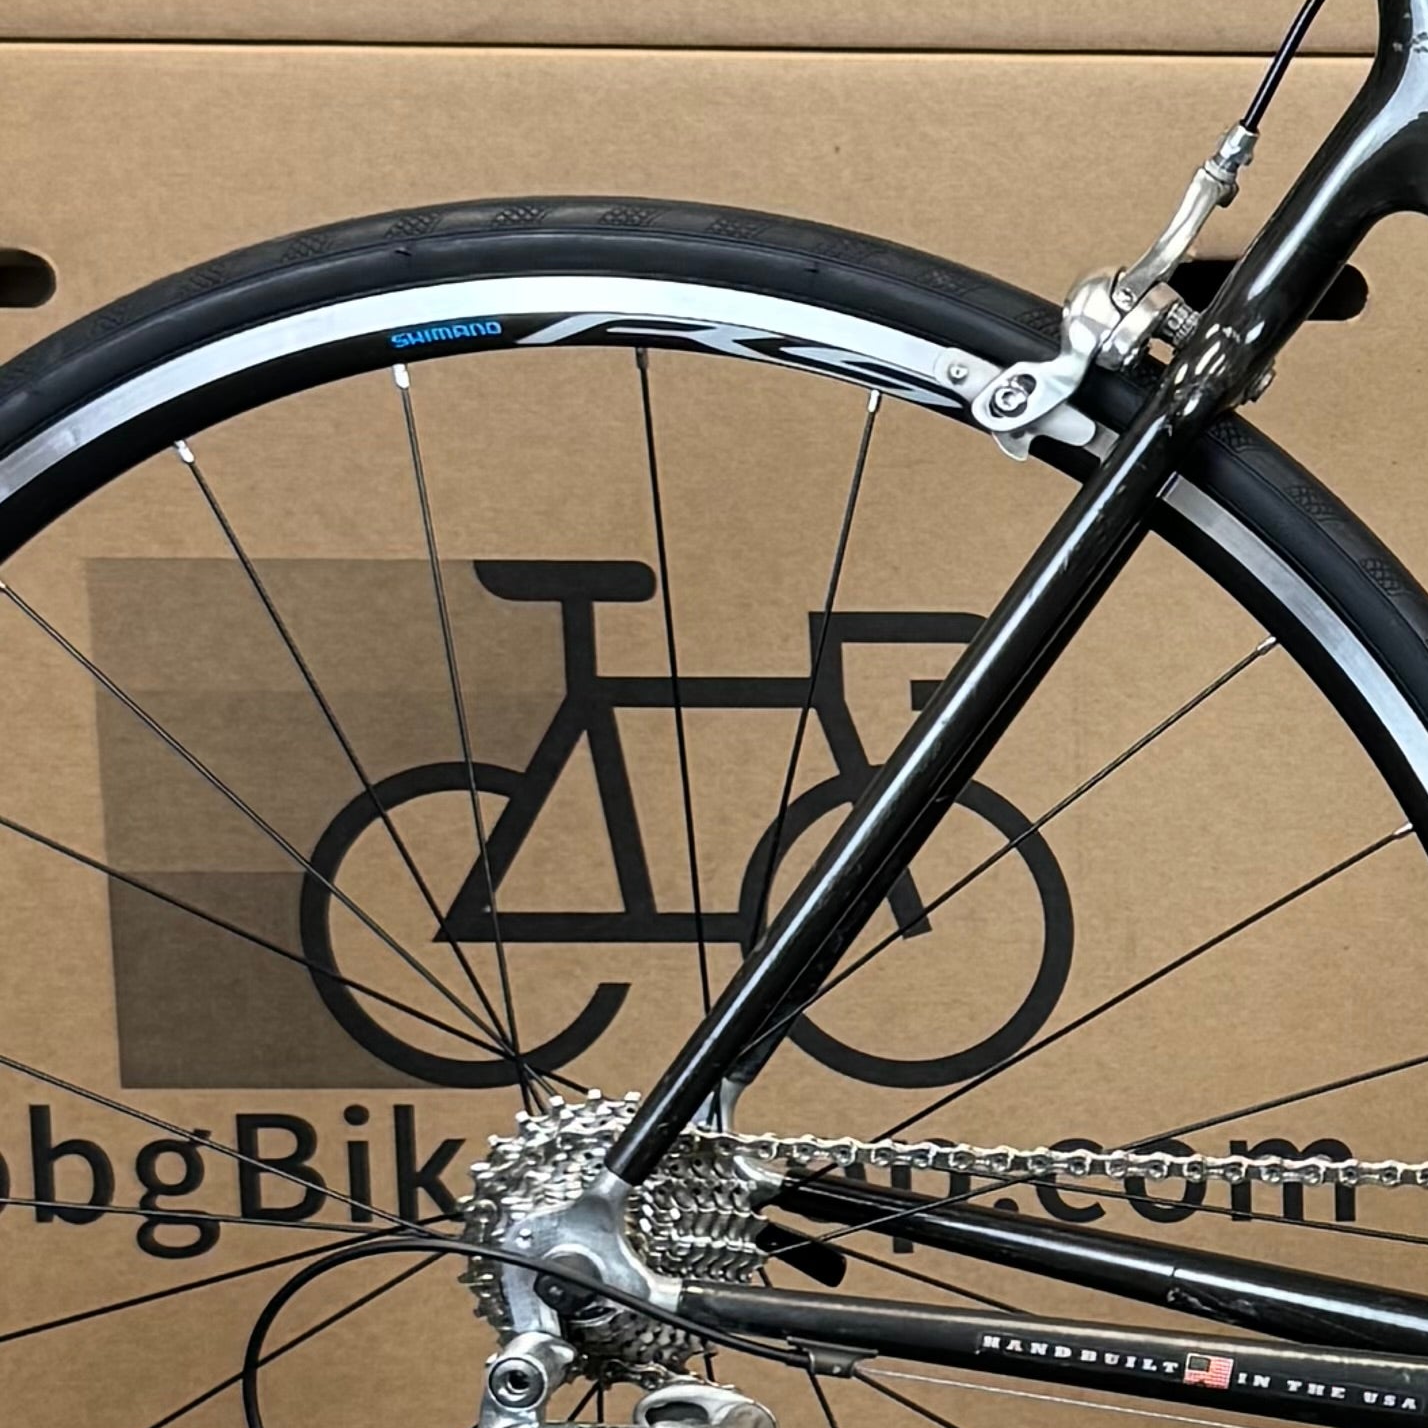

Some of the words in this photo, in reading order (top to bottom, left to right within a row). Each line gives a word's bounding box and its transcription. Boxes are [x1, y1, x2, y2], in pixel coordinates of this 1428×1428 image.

[391, 321, 502, 349] SHIMANO
[983, 1335, 1179, 1374] HANDBUILT
[1238, 1372, 1272, 1389] IN
[1287, 1380, 1347, 1401] THE
[1363, 1391, 1419, 1411] USA
